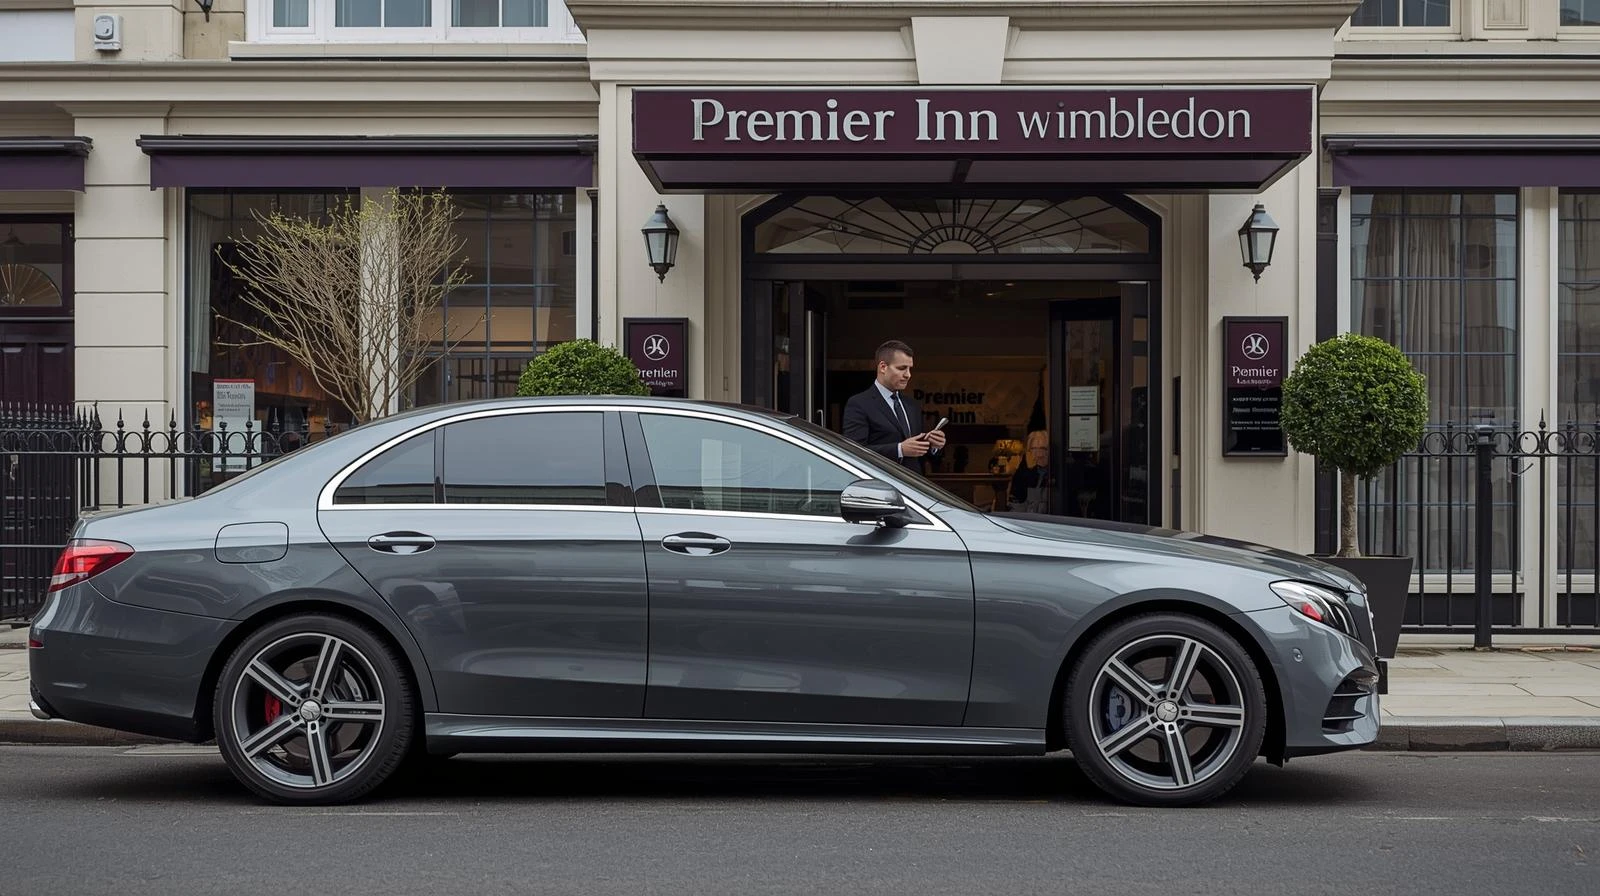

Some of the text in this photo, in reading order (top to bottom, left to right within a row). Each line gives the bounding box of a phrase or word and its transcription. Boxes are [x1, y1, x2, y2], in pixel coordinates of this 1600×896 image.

[691, 96, 1252, 142] Premier Inn wimbledon
[913, 388, 985, 404] Premier
